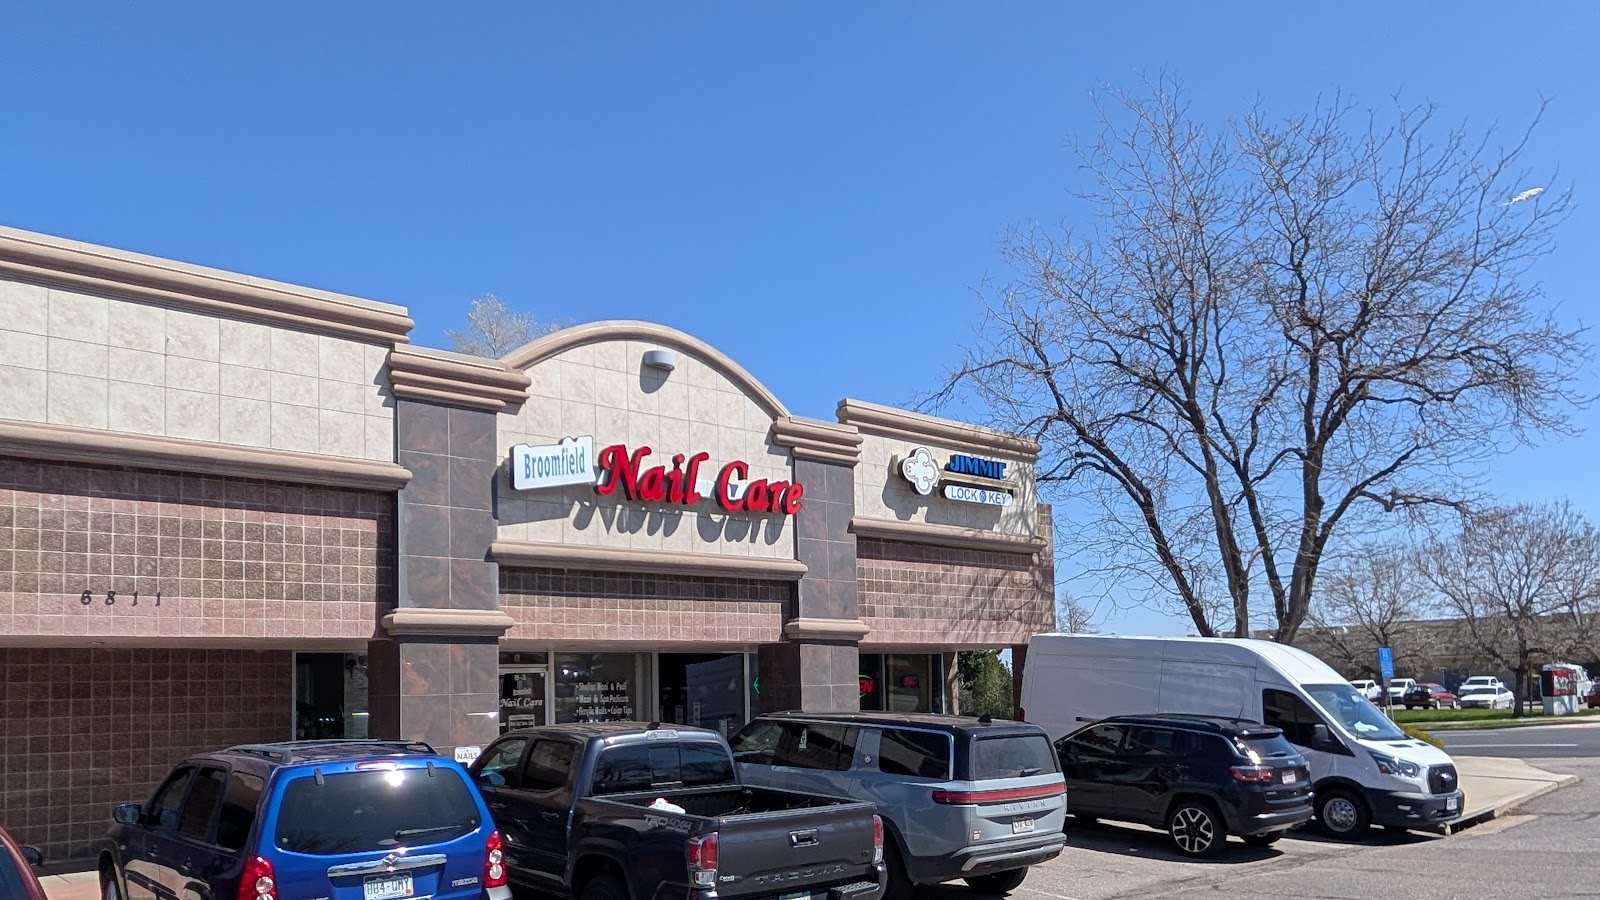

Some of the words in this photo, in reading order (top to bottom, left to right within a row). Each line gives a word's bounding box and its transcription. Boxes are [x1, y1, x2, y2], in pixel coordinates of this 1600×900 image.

[524, 453, 586, 479] Broomfield
[949, 454, 1007, 480] JIMMIE
[594, 444, 709, 505] Nail
[715, 460, 804, 514] Care
[951, 486, 978, 501] LOCK
[988, 492, 1007, 504] KEY
[80, 589, 161, 607] 6811
[500, 697, 522, 708] Nail
[523, 697, 543, 709] Care
[457, 752, 478, 760] NAILS
[1003, 800, 1046, 812] RIVIAN
[754, 864, 844, 884] TACOMA
